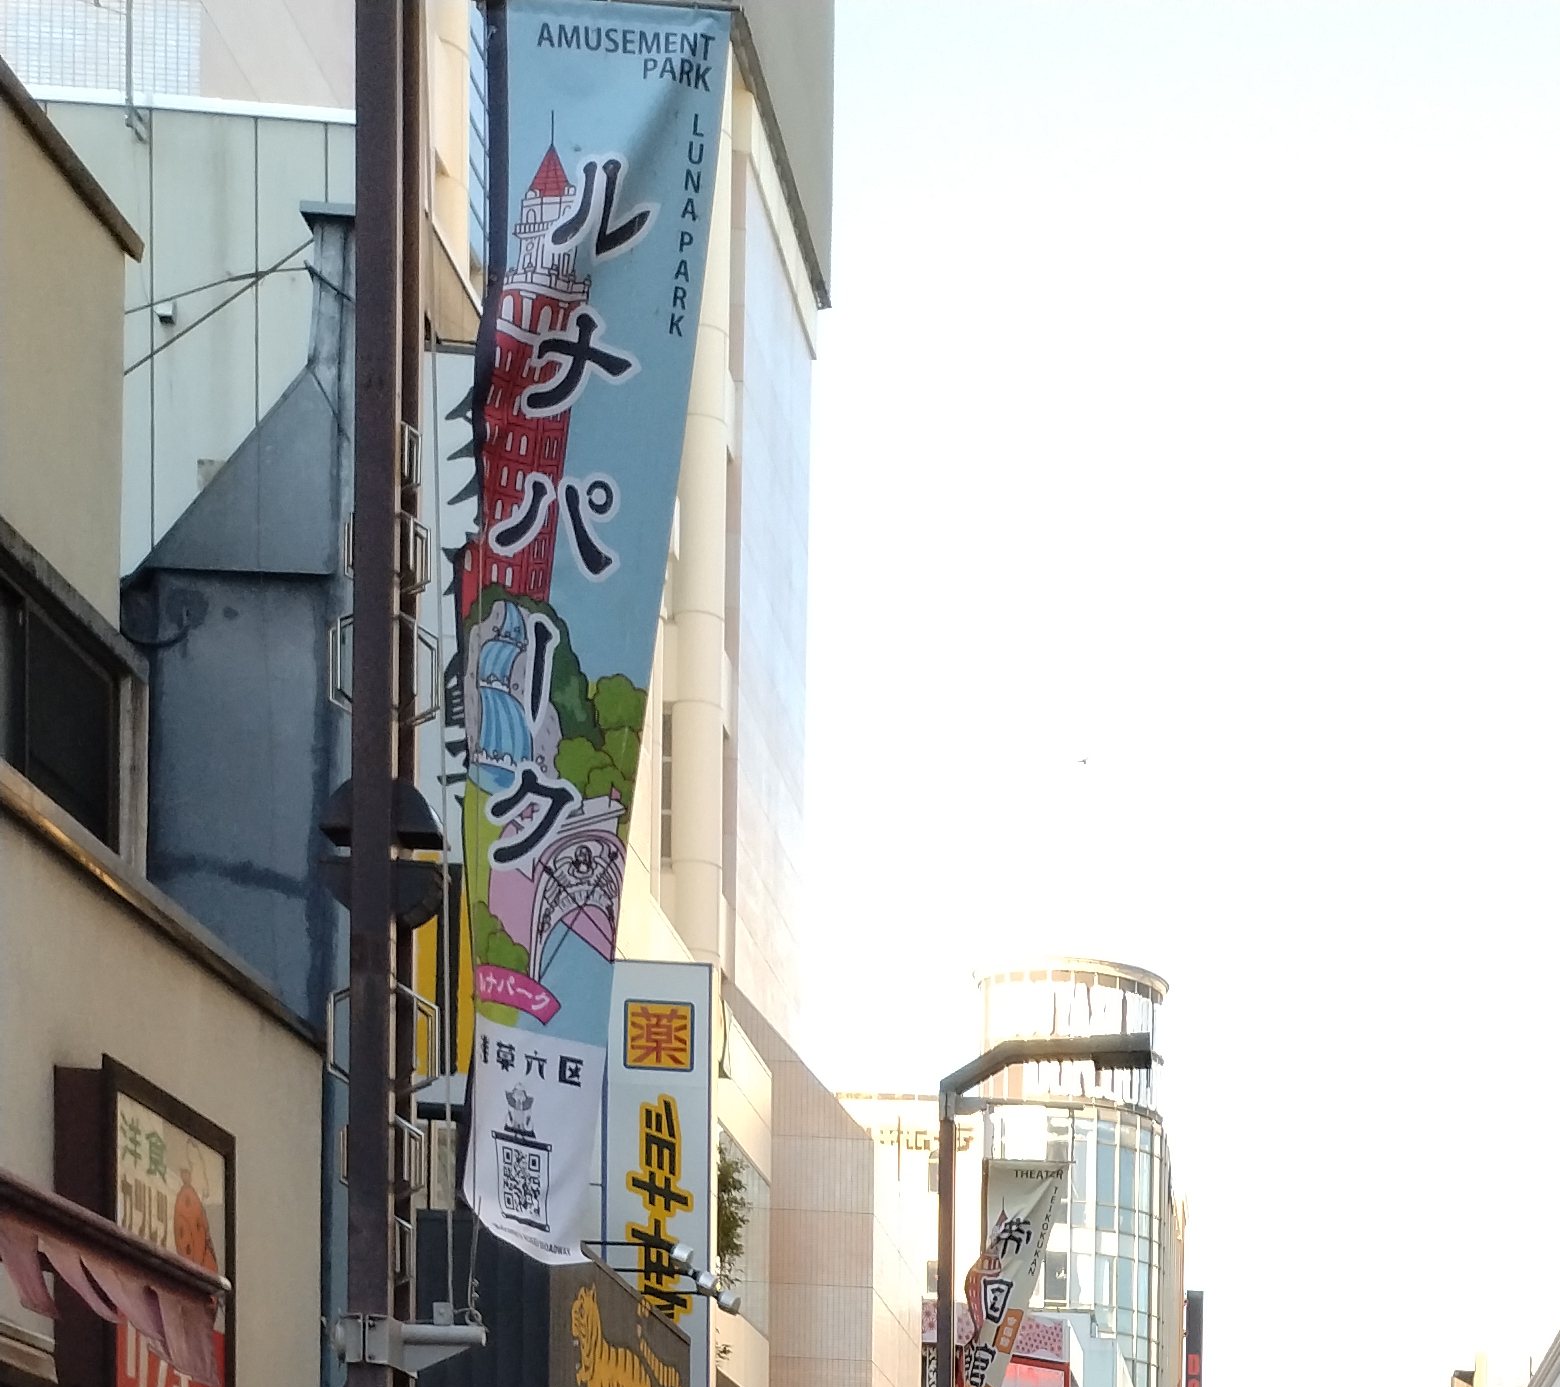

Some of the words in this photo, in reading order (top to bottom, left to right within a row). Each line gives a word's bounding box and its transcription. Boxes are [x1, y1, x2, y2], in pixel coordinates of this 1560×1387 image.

[537, 22, 716, 61] AMUSEMENT
[643, 57, 713, 92] PARK
[680, 113, 704, 222] LUNA
[669, 231, 694, 337] PARK
[491, 157, 652, 863] ルナパーク
[630, 1005, 688, 1066] 薬
[119, 1109, 168, 1186] 洋食
[630, 1098, 690, 1320] ツモトキヨシ
[1028, 1186, 1059, 1276] TEIKOKUKAN
